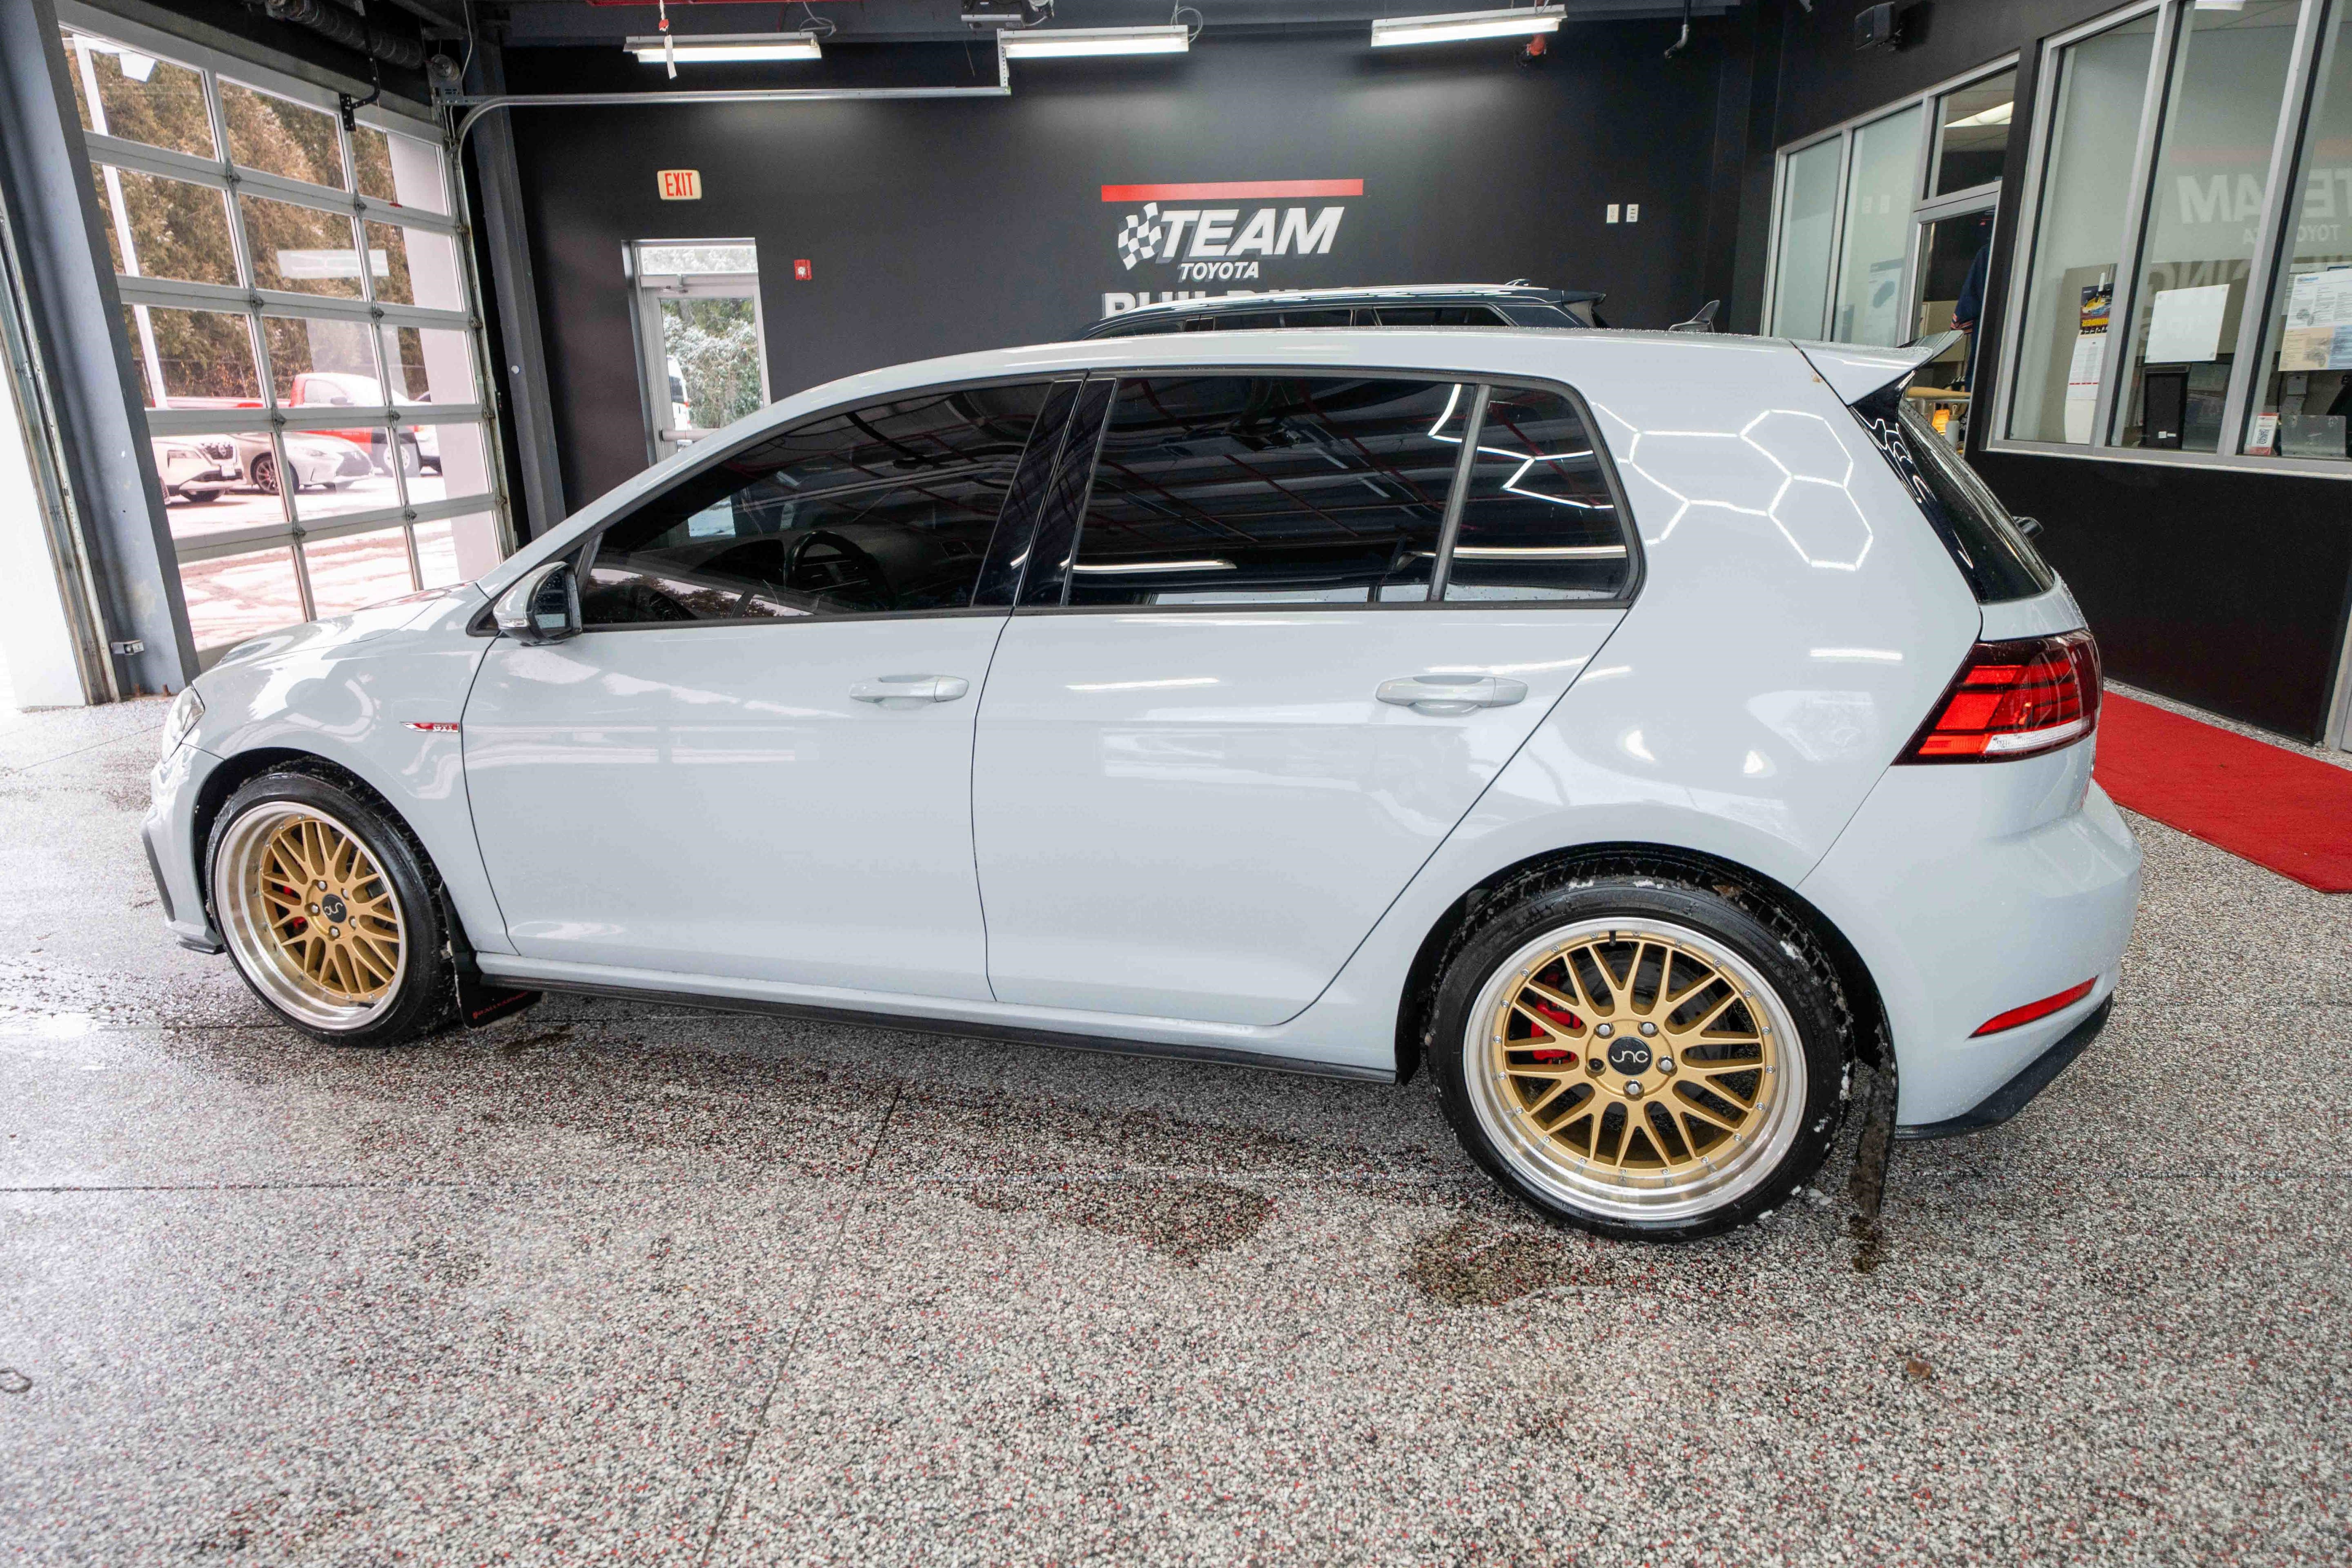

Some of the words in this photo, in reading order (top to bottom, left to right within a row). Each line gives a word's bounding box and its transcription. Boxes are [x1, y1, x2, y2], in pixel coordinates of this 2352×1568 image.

[664, 172, 693, 197] EXIT
[1160, 207, 1345, 258] TEAM
[1180, 261, 1259, 280] TOYOTA
